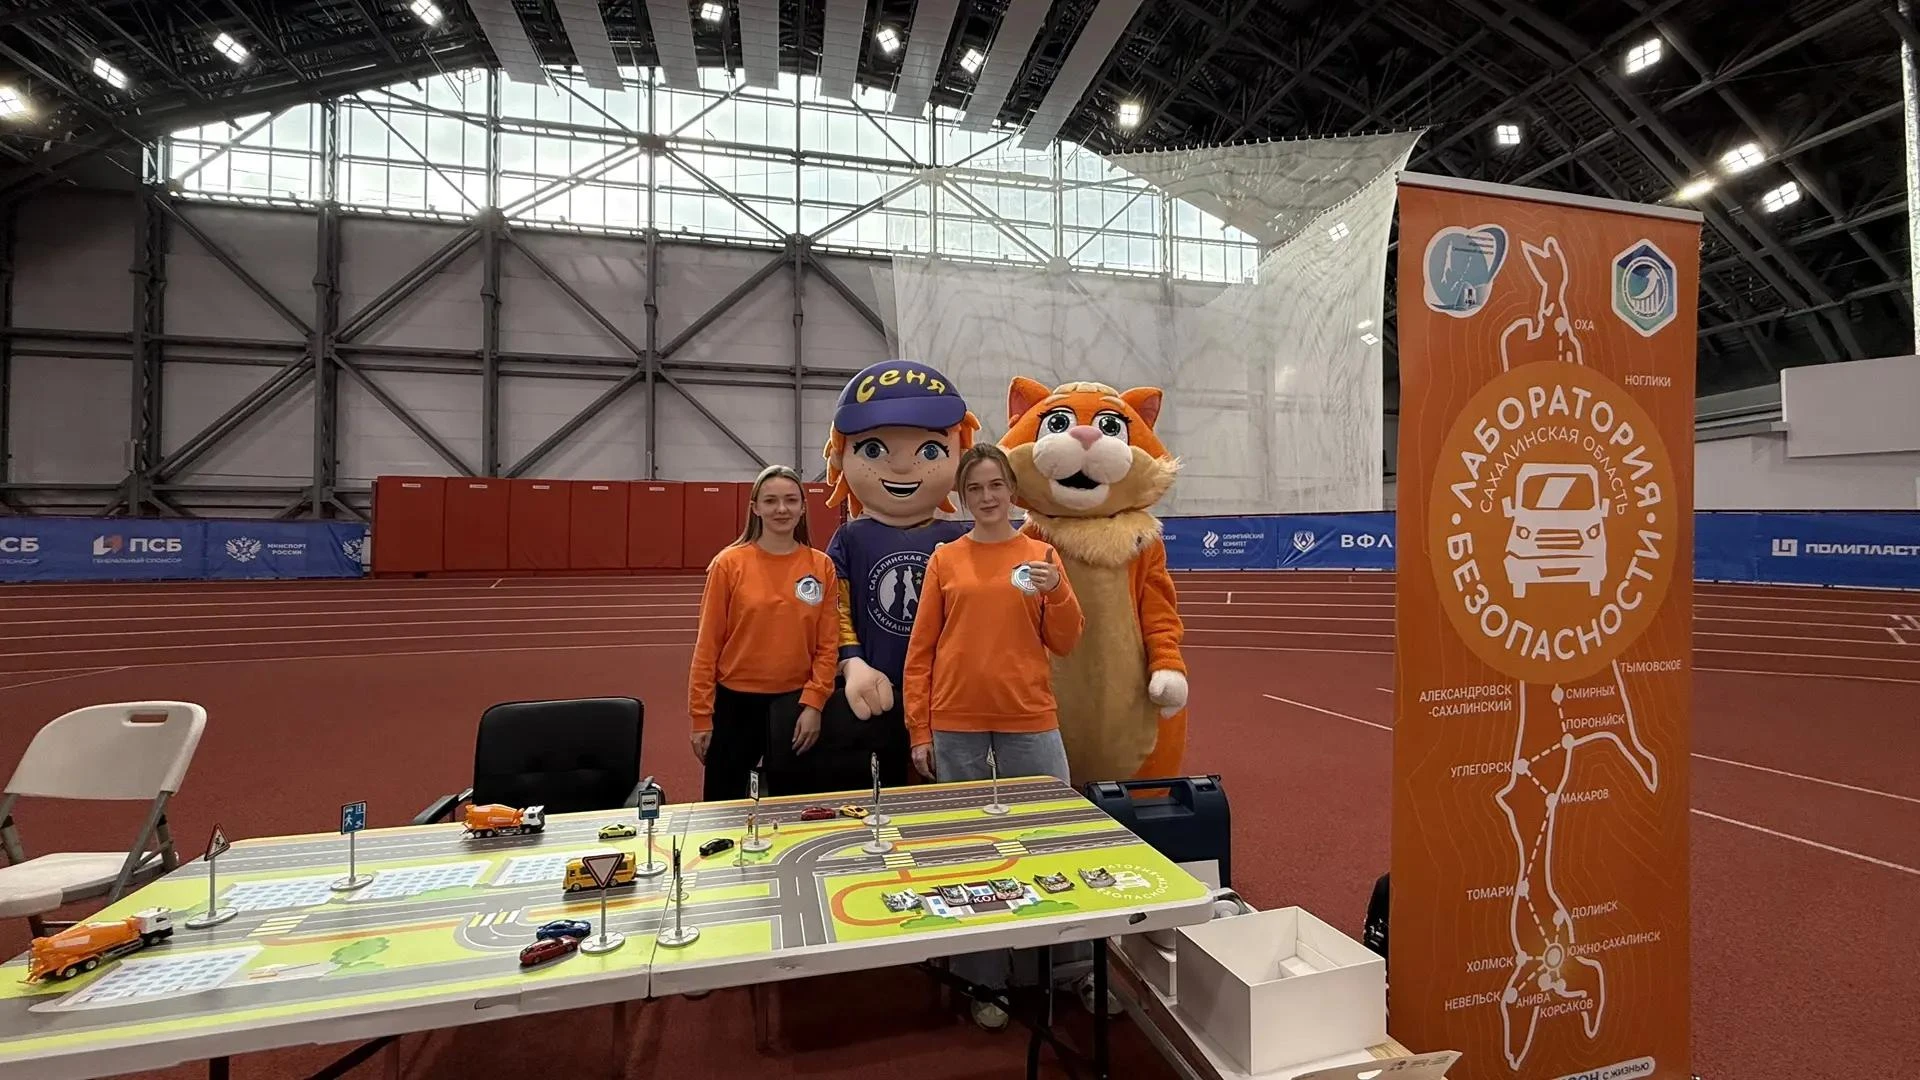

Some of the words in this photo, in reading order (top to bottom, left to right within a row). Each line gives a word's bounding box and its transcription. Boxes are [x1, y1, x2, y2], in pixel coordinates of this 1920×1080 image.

[1574, 319, 1595, 331] ОХА
[1625, 374, 1672, 387] НОГЛИКИ
[1451, 384, 1662, 508] ЛАБОРАТОРИЯ
[1480, 426, 1579, 513] САХАЛИНСКАЯ
[1583, 436, 1628, 516] ОБЛАСТЬ
[0, 537, 40, 552] СБ
[129, 537, 182, 553] ПСБ
[1806, 543, 1920, 556] ПОЛИПЛАСТ
[869, 554, 922, 591] САХАЛИНСКАЯ
[1447, 529, 1664, 662] БЕЗОПАСНОСТИ
[873, 608, 911, 632] SAKHALIN
[1620, 659, 1682, 673] ТЫМОВСКОЕ
[1419, 684, 1512, 702] АЛЕКСАНДРОВСК
[1566, 685, 1616, 699] СМИРНЫХ
[1428, 700, 1512, 718] -САХАЛИНСКИЙ
[1566, 713, 1625, 729] ПОРОНАЙСК
[1450, 761, 1511, 778] УГЛЕГОРСК
[1560, 788, 1609, 804] МАКАРОВ
[1466, 885, 1514, 900] ТОМАРИ
[1571, 900, 1618, 919] ДОЛИНСК
[1567, 931, 1661, 957] ЮЖНО-САХАЛИНСК
[1466, 957, 1514, 972] ХОЛМСК
[1444, 991, 1500, 1011] НЕВЕЛЬСК
[1515, 992, 1551, 1009] АНИВА
[1540, 998, 1593, 1018] КОРСАКОВ
